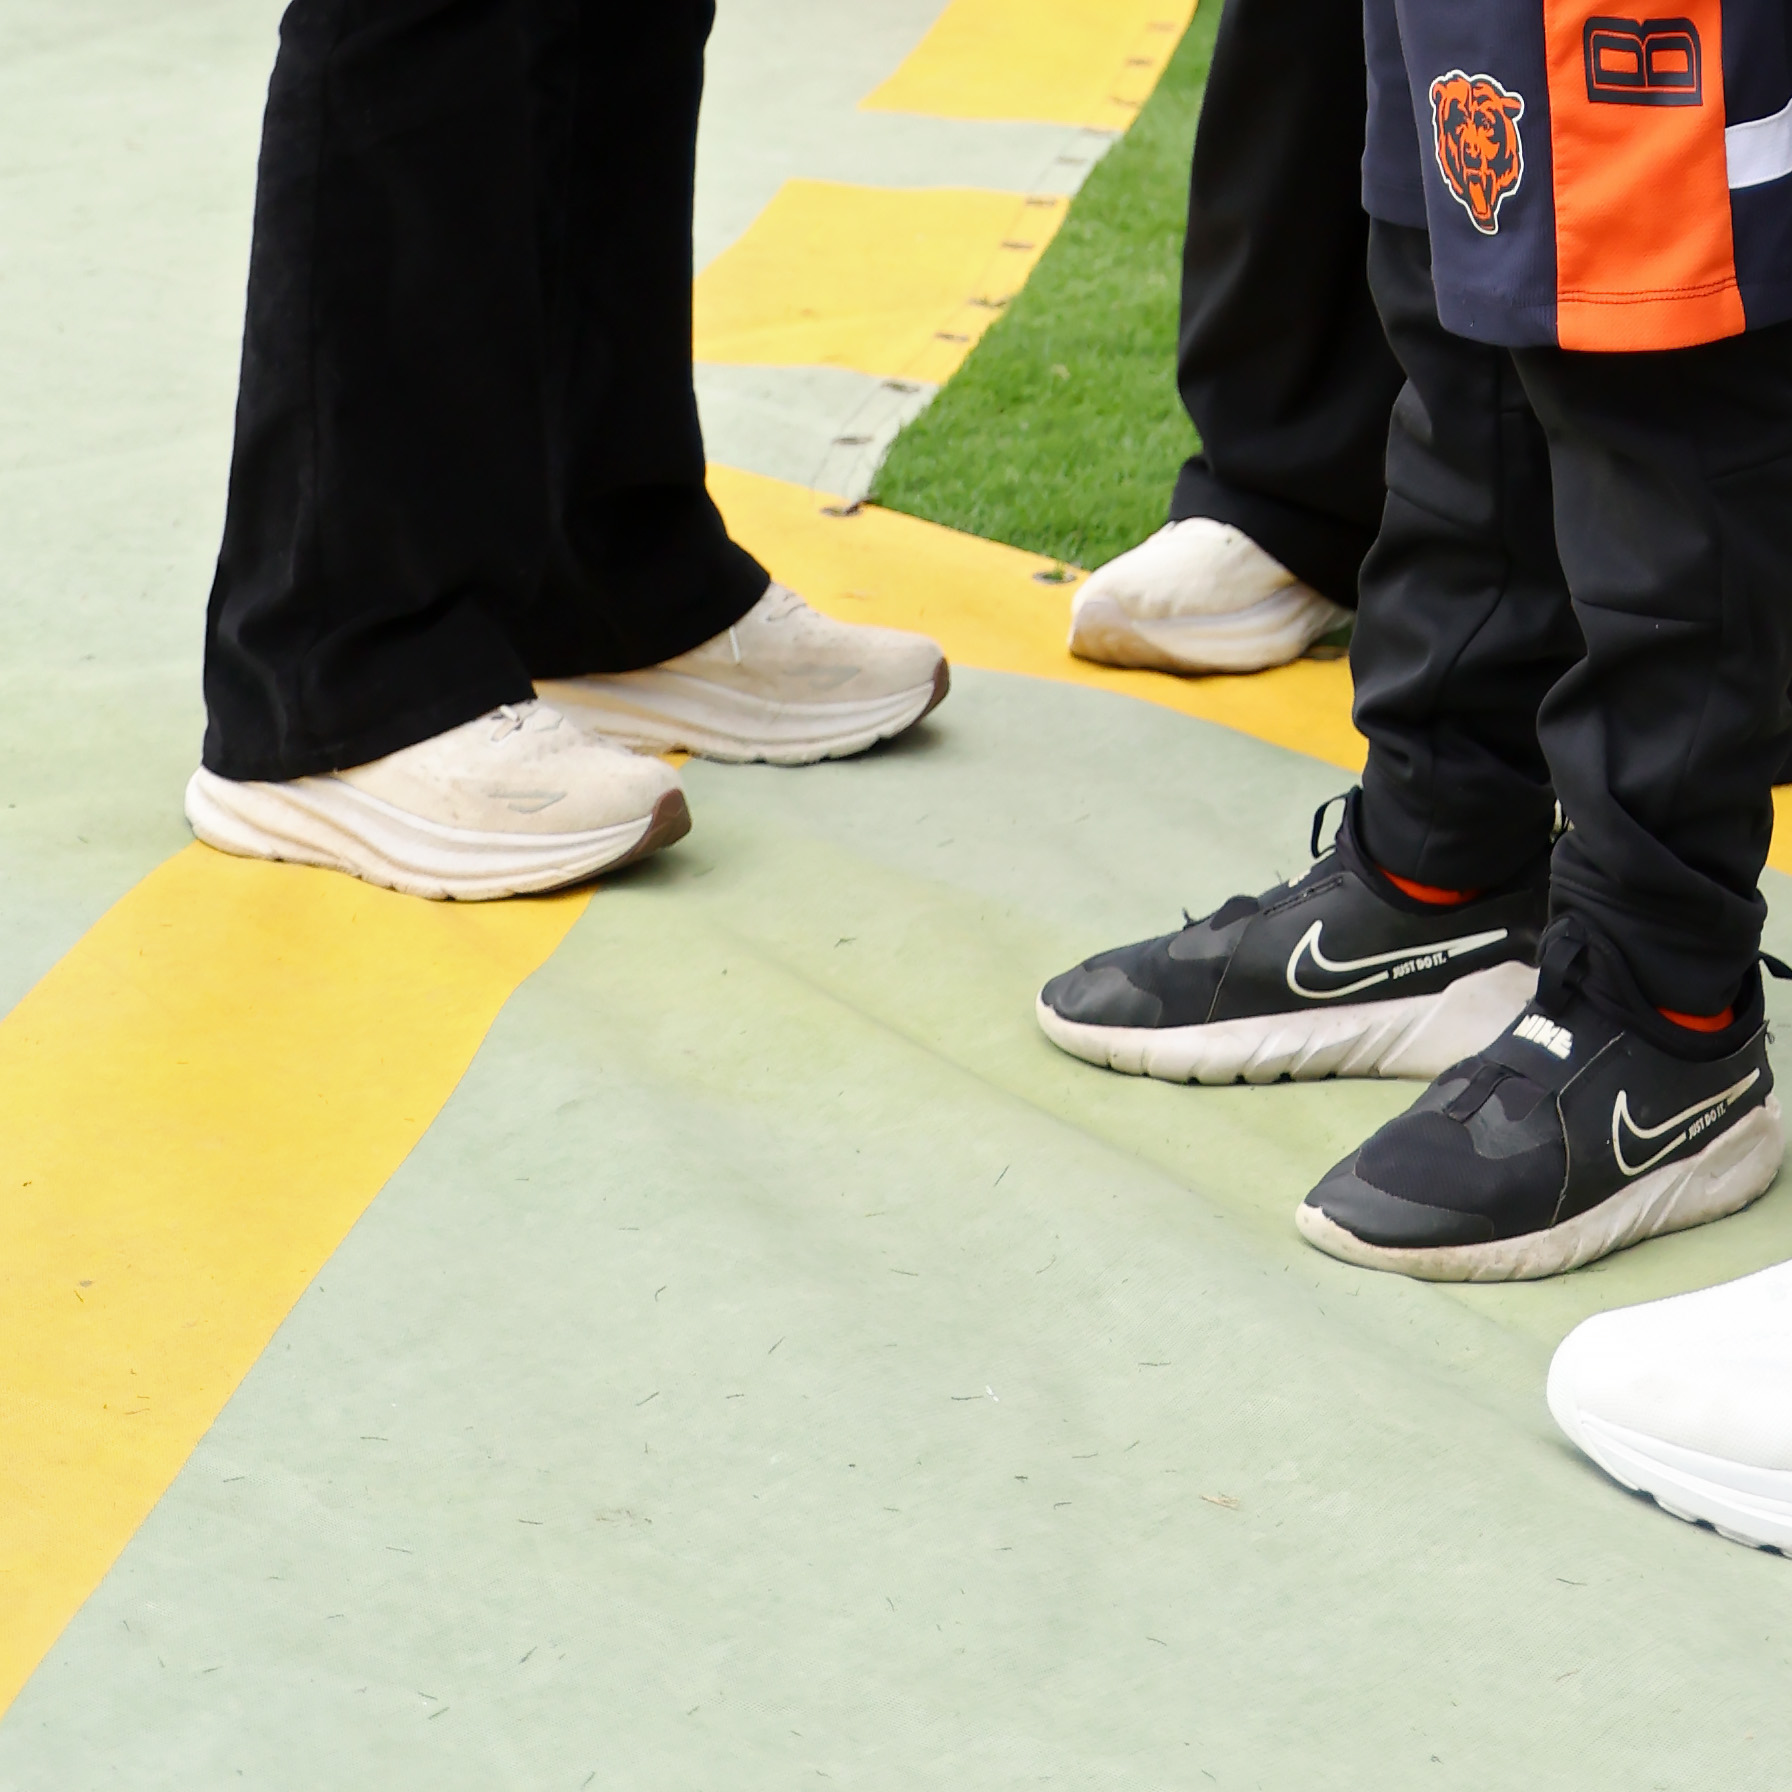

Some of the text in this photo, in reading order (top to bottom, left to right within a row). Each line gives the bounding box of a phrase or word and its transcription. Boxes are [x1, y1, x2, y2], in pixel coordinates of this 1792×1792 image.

[1392, 959, 1416, 980] JUST
[1416, 955, 1433, 972] DO
[1512, 1013, 1574, 1060] NIKE
[1688, 1116, 1705, 1140] JUST
[1704, 1109, 1717, 1127] DO
